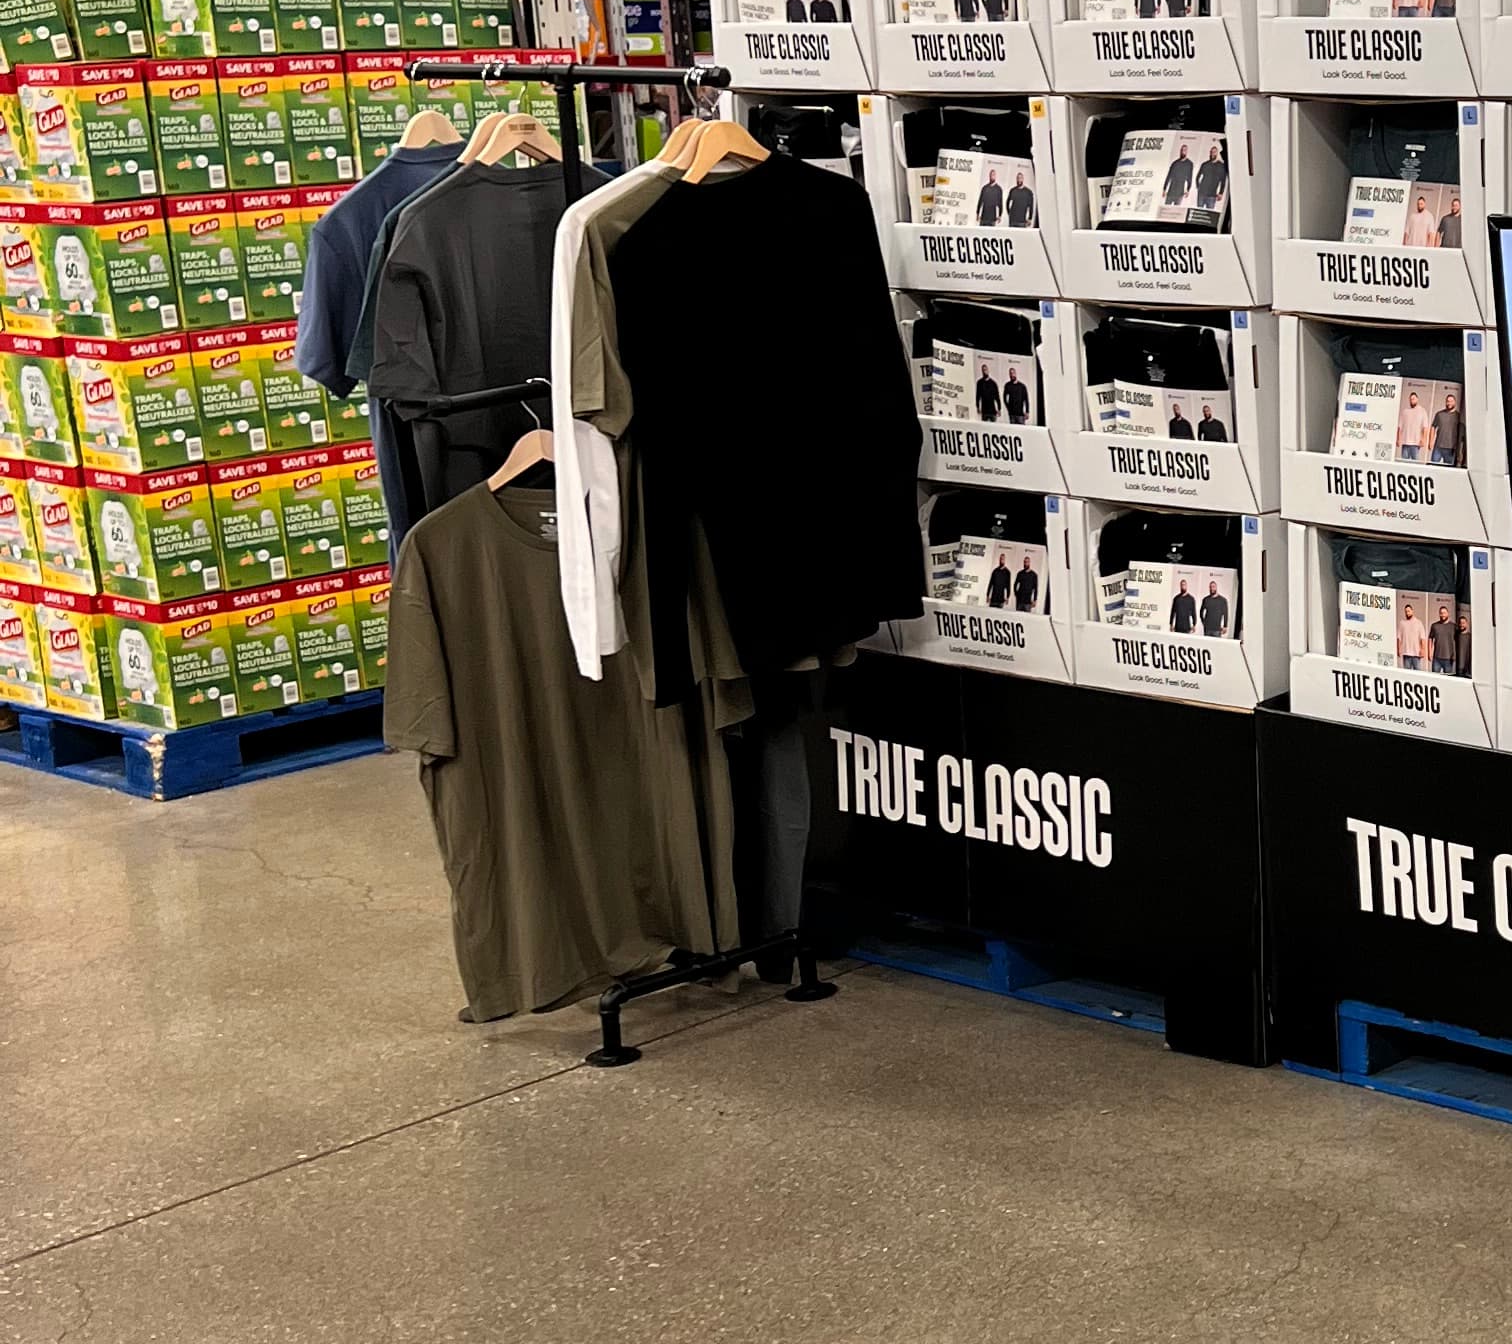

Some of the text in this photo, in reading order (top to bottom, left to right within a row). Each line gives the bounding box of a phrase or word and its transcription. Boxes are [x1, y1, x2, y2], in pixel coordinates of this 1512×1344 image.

[744, 33, 830, 61] TRUE CLASSIC
[912, 34, 1006, 61] TRUE CLASSIC
[1093, 29, 1195, 60] TRUE CLASSIC
[1305, 30, 1422, 61] TRUE CLASSIC
[38, 109, 65, 133] GLAD
[5, 243, 31, 265] GLAD
[920, 235, 1015, 266] TRUE CLASSIC
[1100, 243, 1204, 274] TRUE CLASSIC
[1317, 253, 1430, 288] TRUE CLASSIC
[930, 428, 1024, 462] TRUE CLASSIC
[1108, 446, 1210, 480] TRUE CLASSIC
[1324, 466, 1435, 506] TRUE CLASSIC
[233, 591, 259, 606] SAVE
[296, 579, 322, 594] SAVE
[168, 604, 196, 618] SAVE
[247, 610, 274, 625] GLAD
[310, 599, 336, 614] GLAD
[183, 621, 211, 637] GLAD
[298, 629, 327, 640] TRAPS,
[934, 610, 1026, 648] TRUE CLASSIC
[236, 641, 265, 652] TRAPS,
[237, 650, 264, 661] LOCKS
[238, 652, 292, 669] NEUTRALIZES
[1112, 638, 1213, 676] TRUE CLASSIC
[1332, 669, 1441, 714] TRUE CLASSIC
[829, 726, 1114, 868] TRUE CLASSIC
[1346, 817, 1480, 933] TRUE
